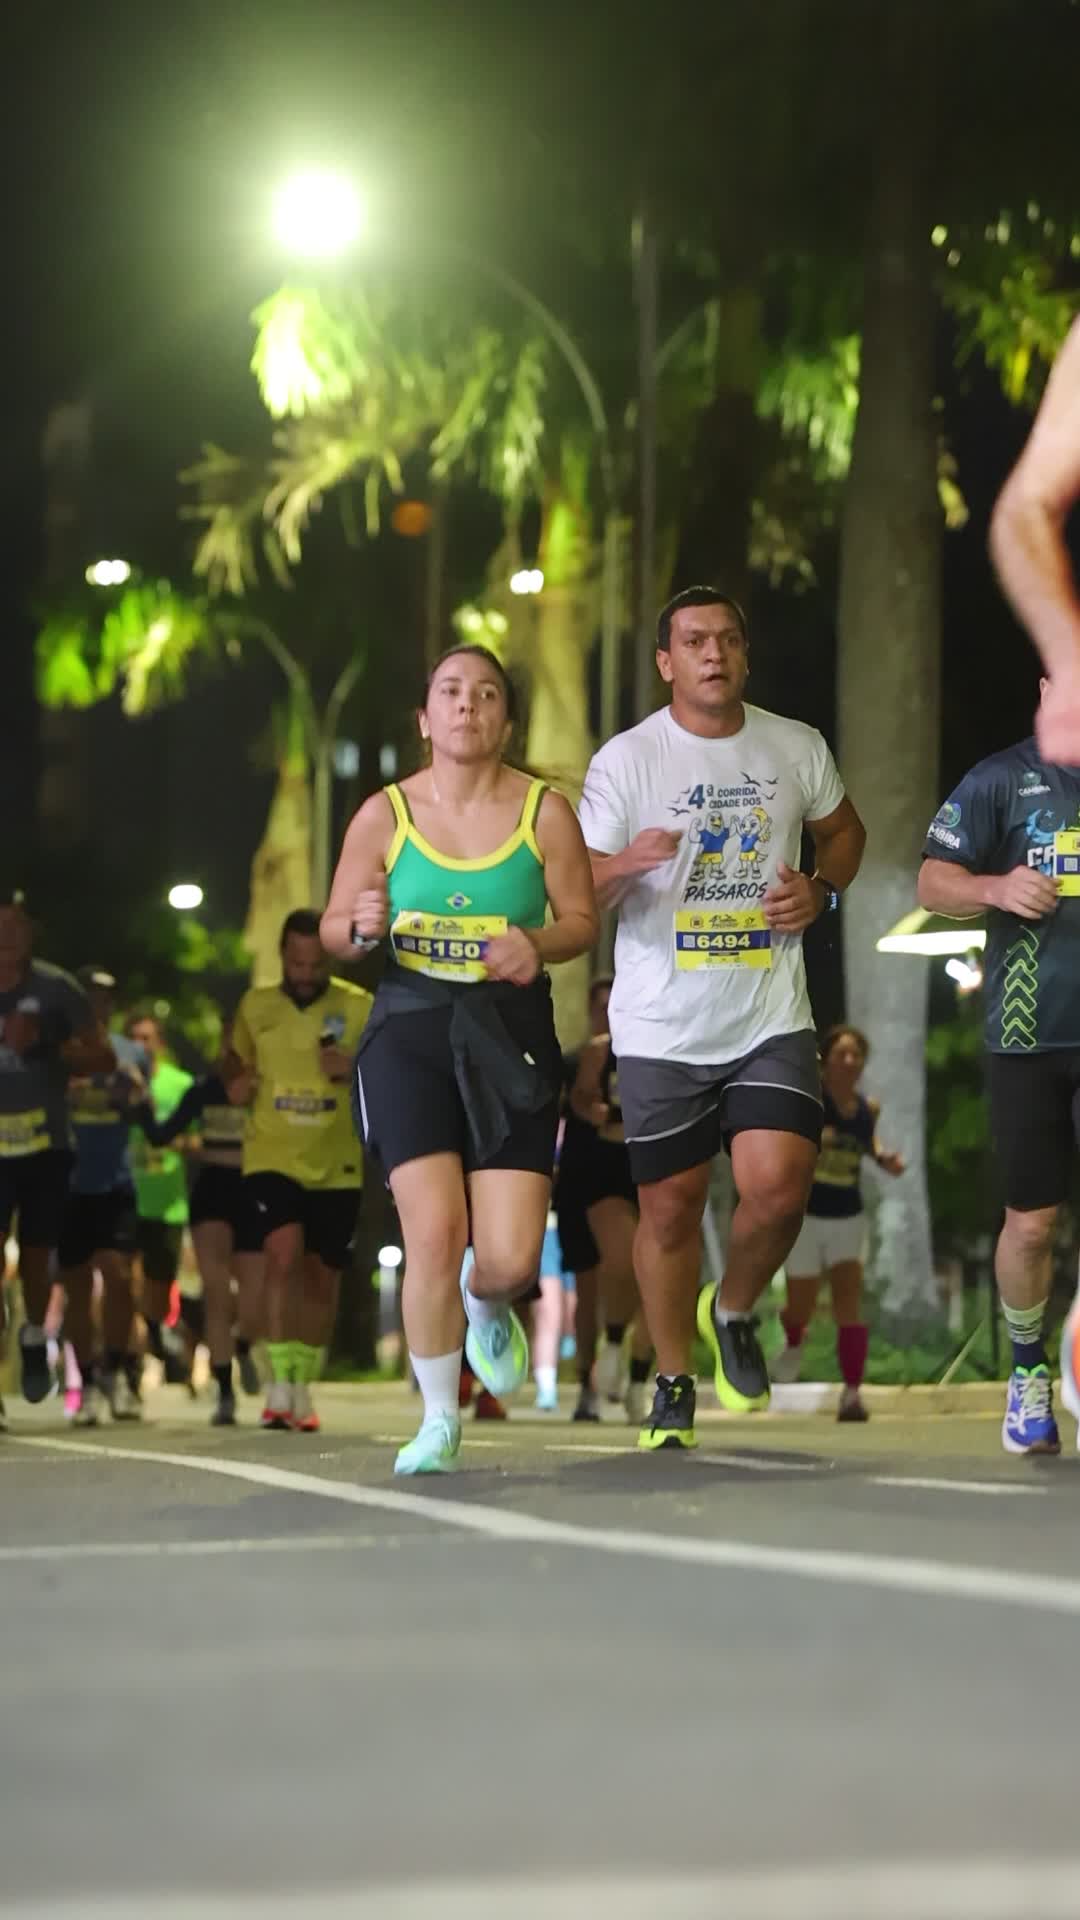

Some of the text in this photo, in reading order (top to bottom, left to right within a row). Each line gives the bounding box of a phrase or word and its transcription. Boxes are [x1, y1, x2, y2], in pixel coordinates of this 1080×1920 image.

[717, 787, 757, 798] CORRIDA
[709, 797, 762, 809] CIDADE DOS
[696, 933, 751, 949] 6494
[418, 939, 480, 959] 5150
